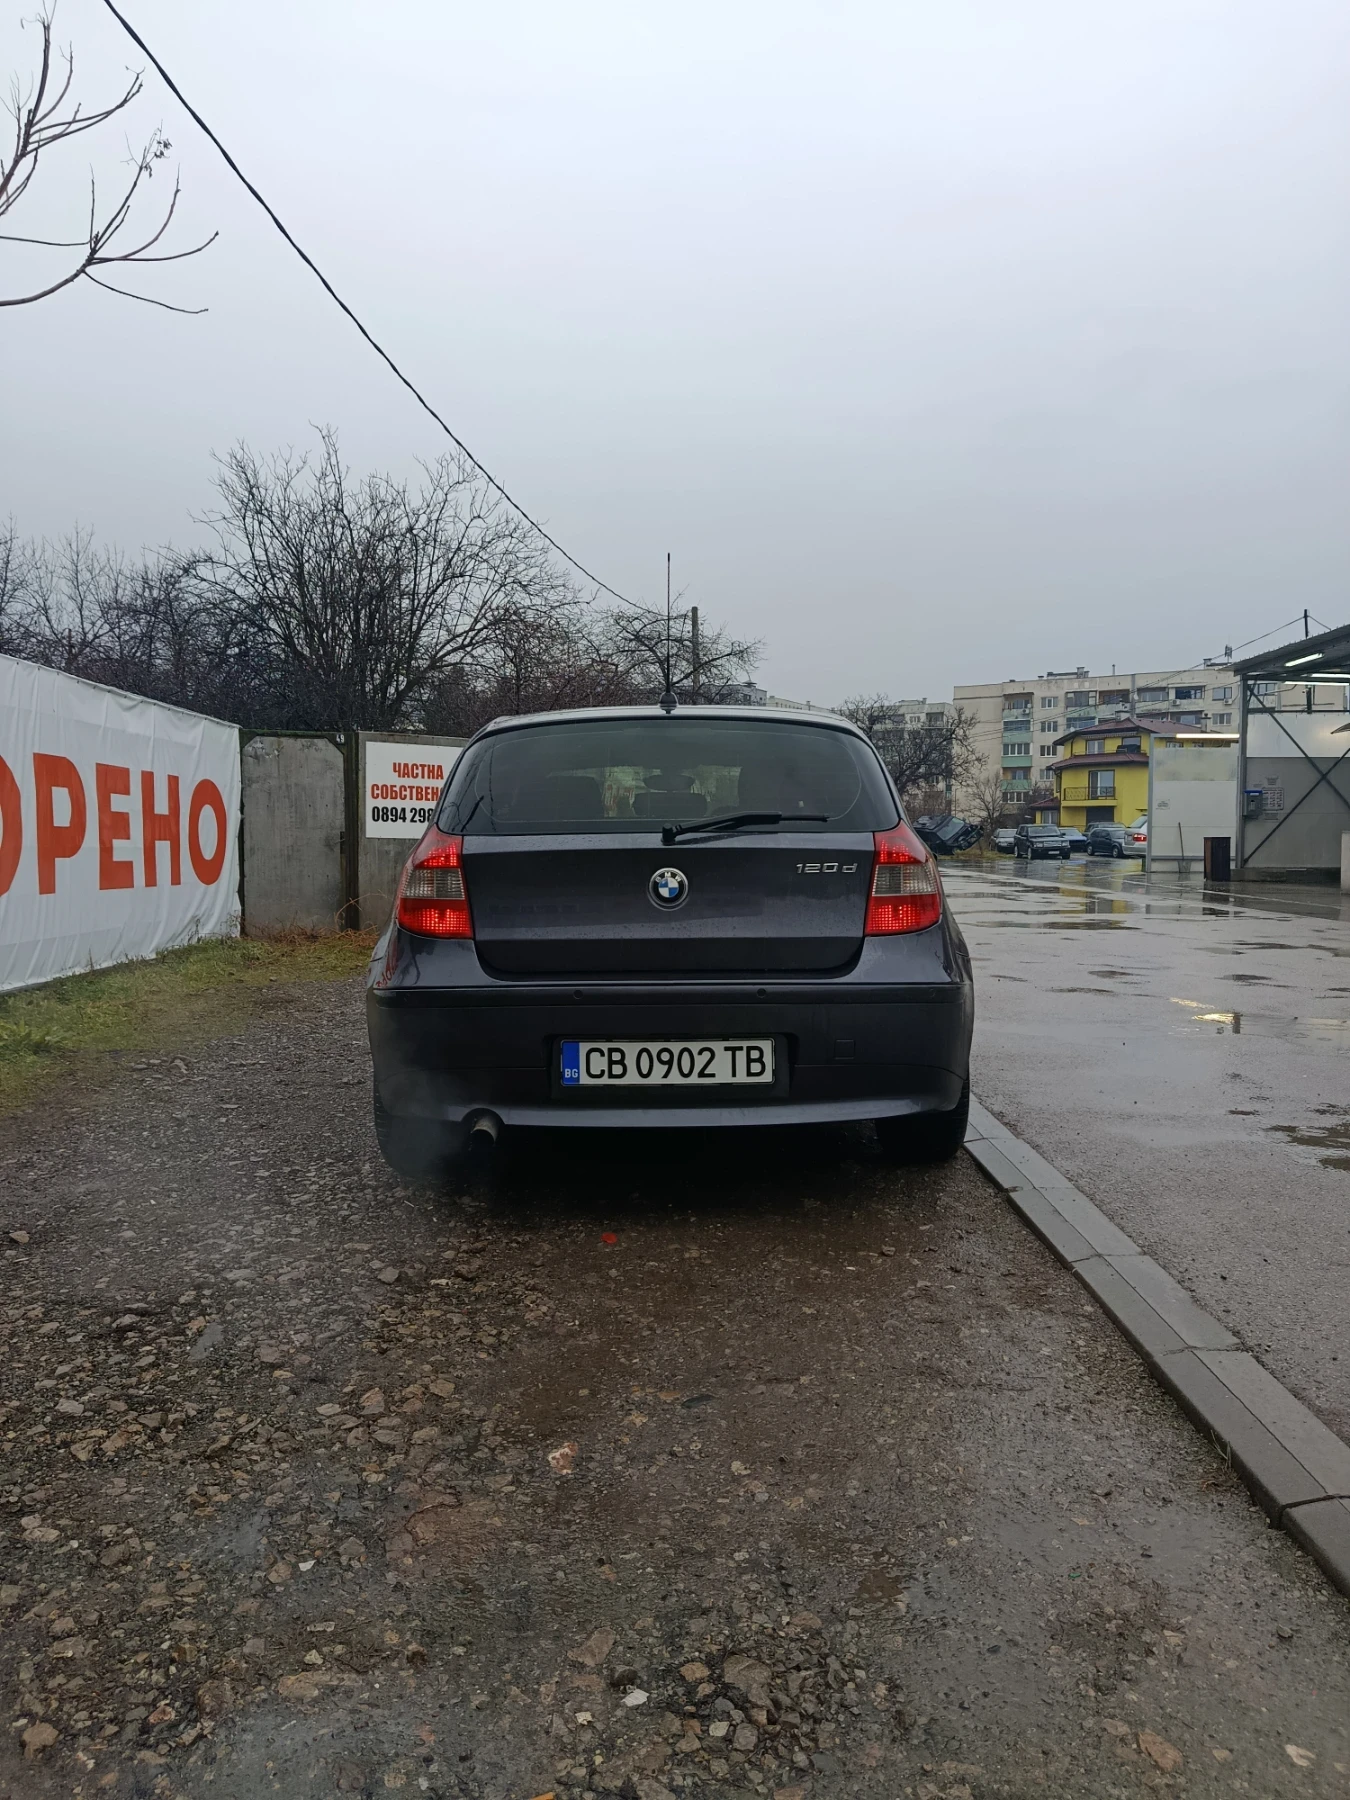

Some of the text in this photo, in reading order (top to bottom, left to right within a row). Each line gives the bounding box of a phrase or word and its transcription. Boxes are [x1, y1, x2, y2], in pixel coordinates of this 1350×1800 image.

[393, 762, 444, 779] ЧАСТНА
[371, 784, 443, 801] СОБСТВЕН
[372, 806, 407, 822] 0894
[655, 871, 682, 883] BMW
[585, 1045, 767, 1079] CB 0902 TB
[564, 1068, 579, 1078] BG
